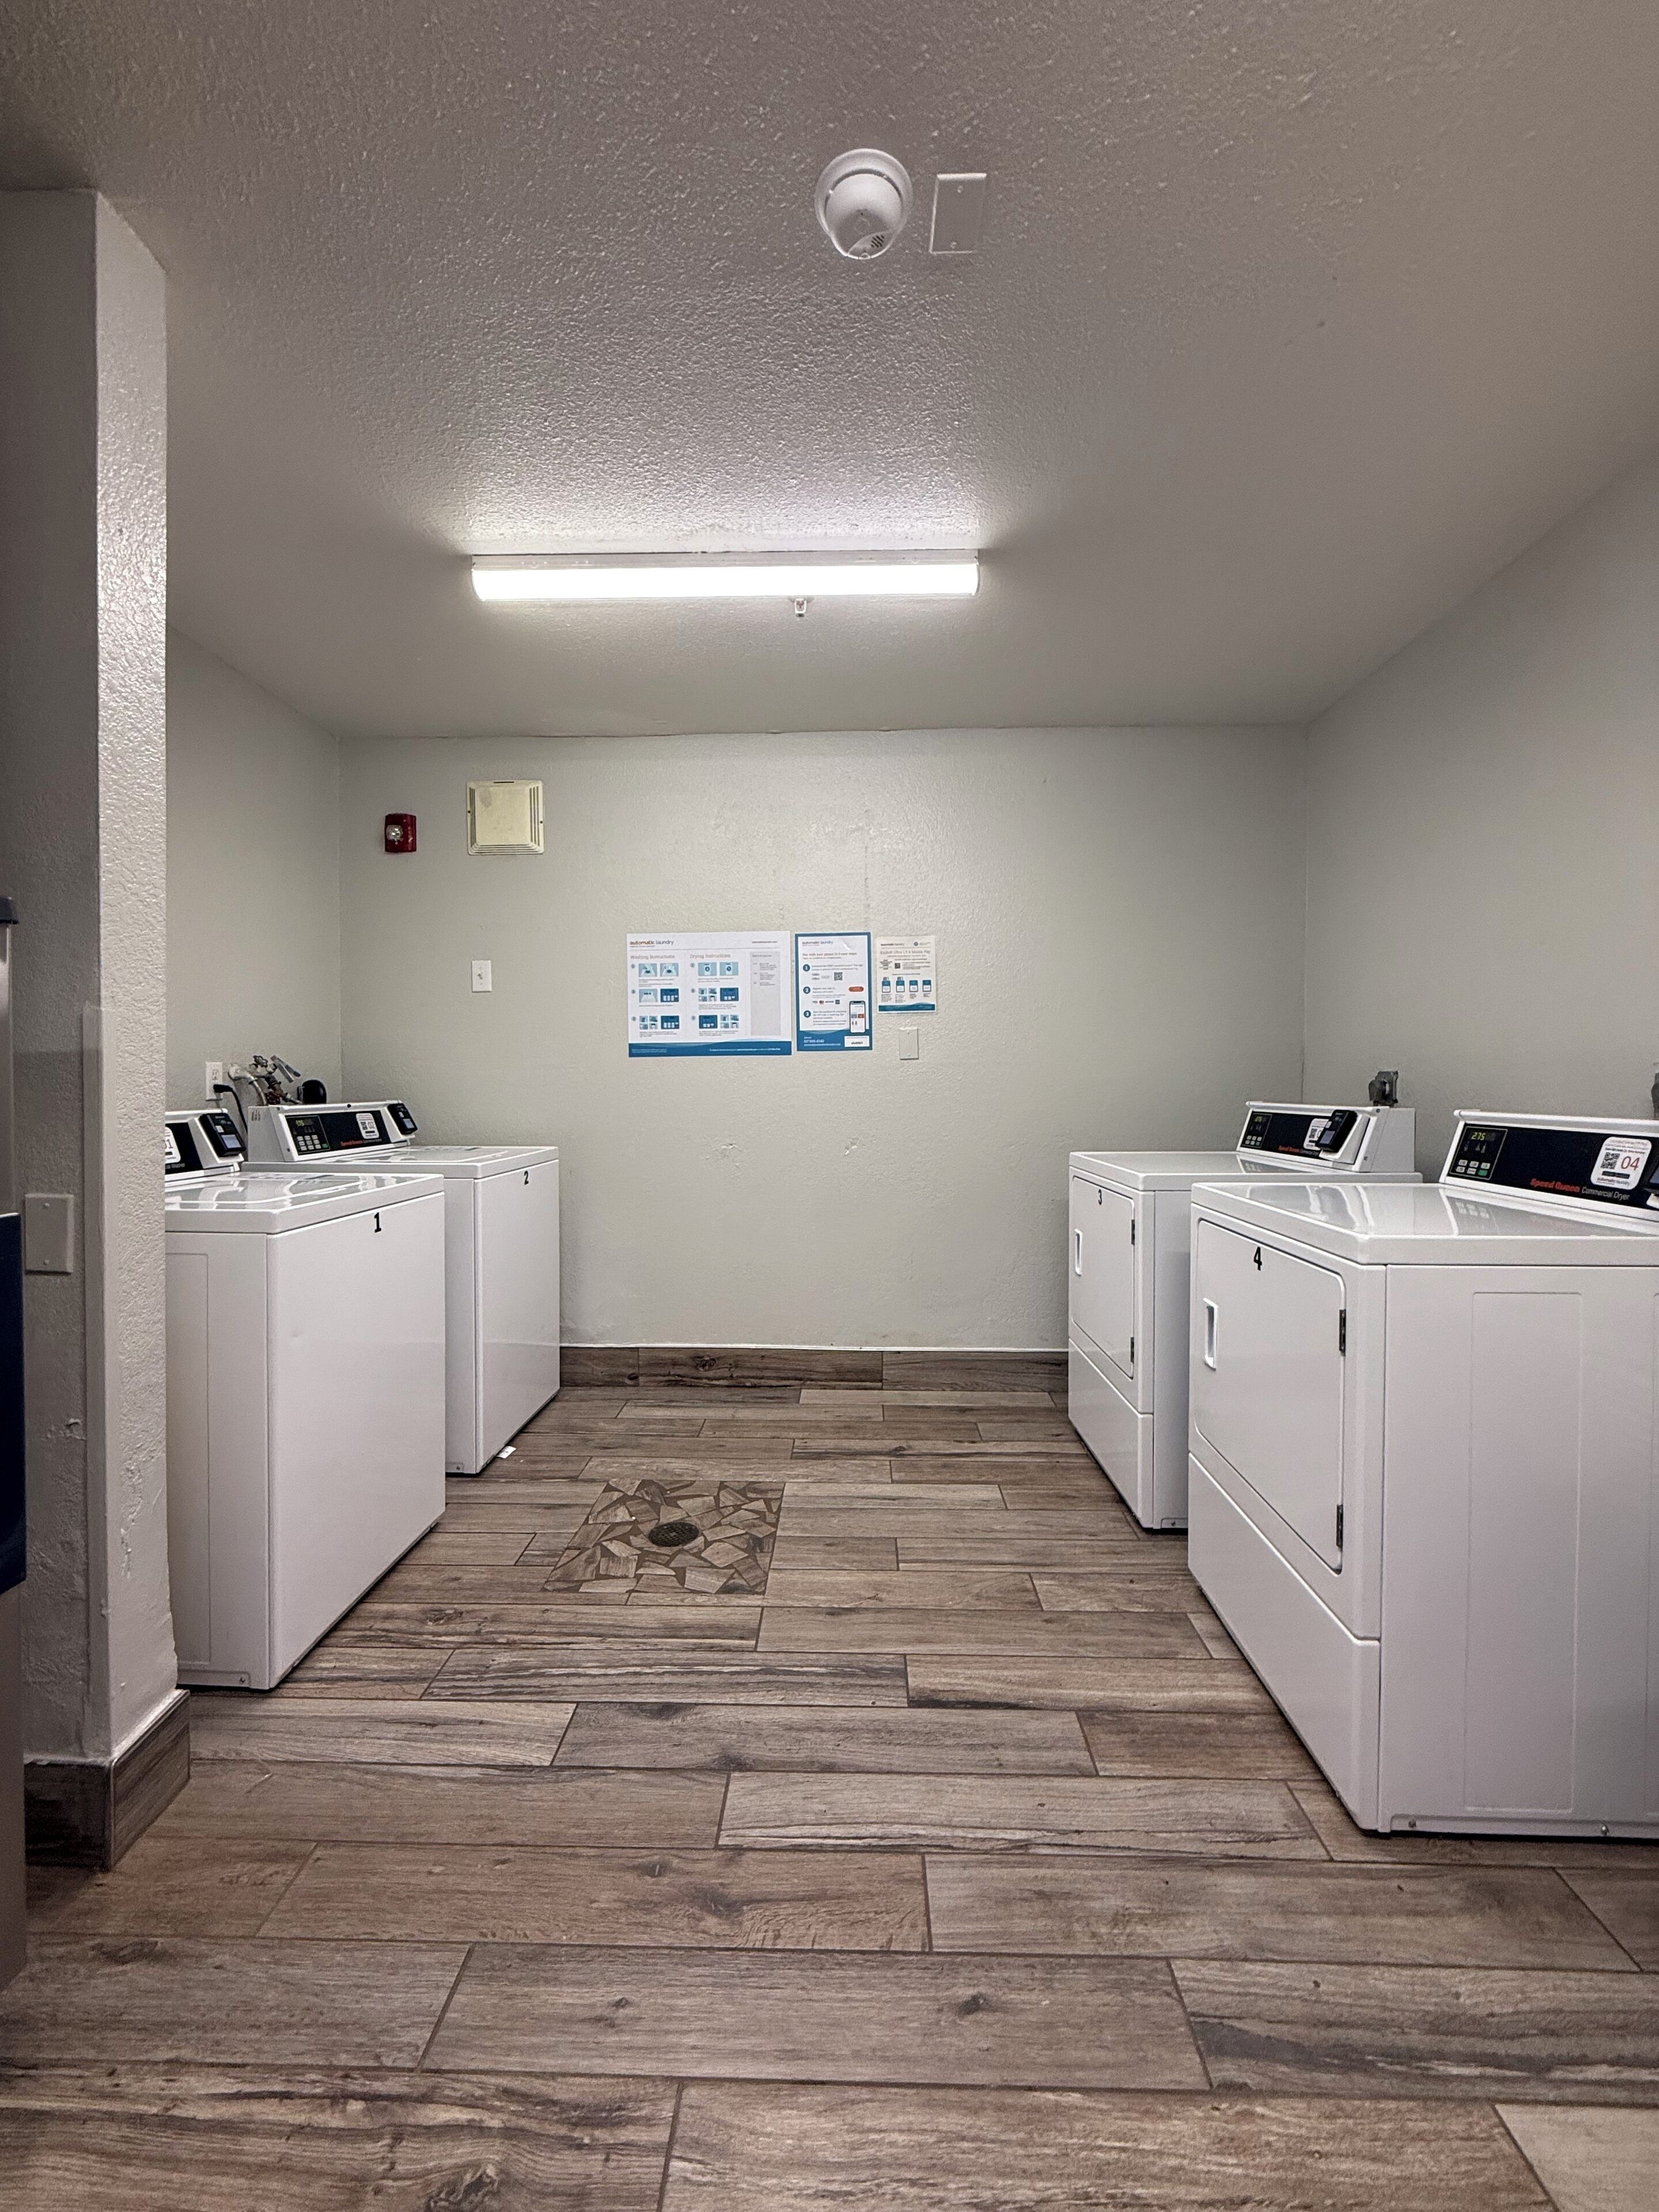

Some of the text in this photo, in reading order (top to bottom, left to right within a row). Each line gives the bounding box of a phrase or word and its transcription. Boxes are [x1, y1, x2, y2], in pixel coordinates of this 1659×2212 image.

[1620, 1156, 1640, 1171] 04
[524, 1171, 529, 1185] 2
[1098, 1189, 1102, 1205] 3
[1530, 1178, 1630, 1201] Speed Queen Commercial Dryer
[374, 1212, 381, 1233] 1
[1253, 1247, 1262, 1271] 4
